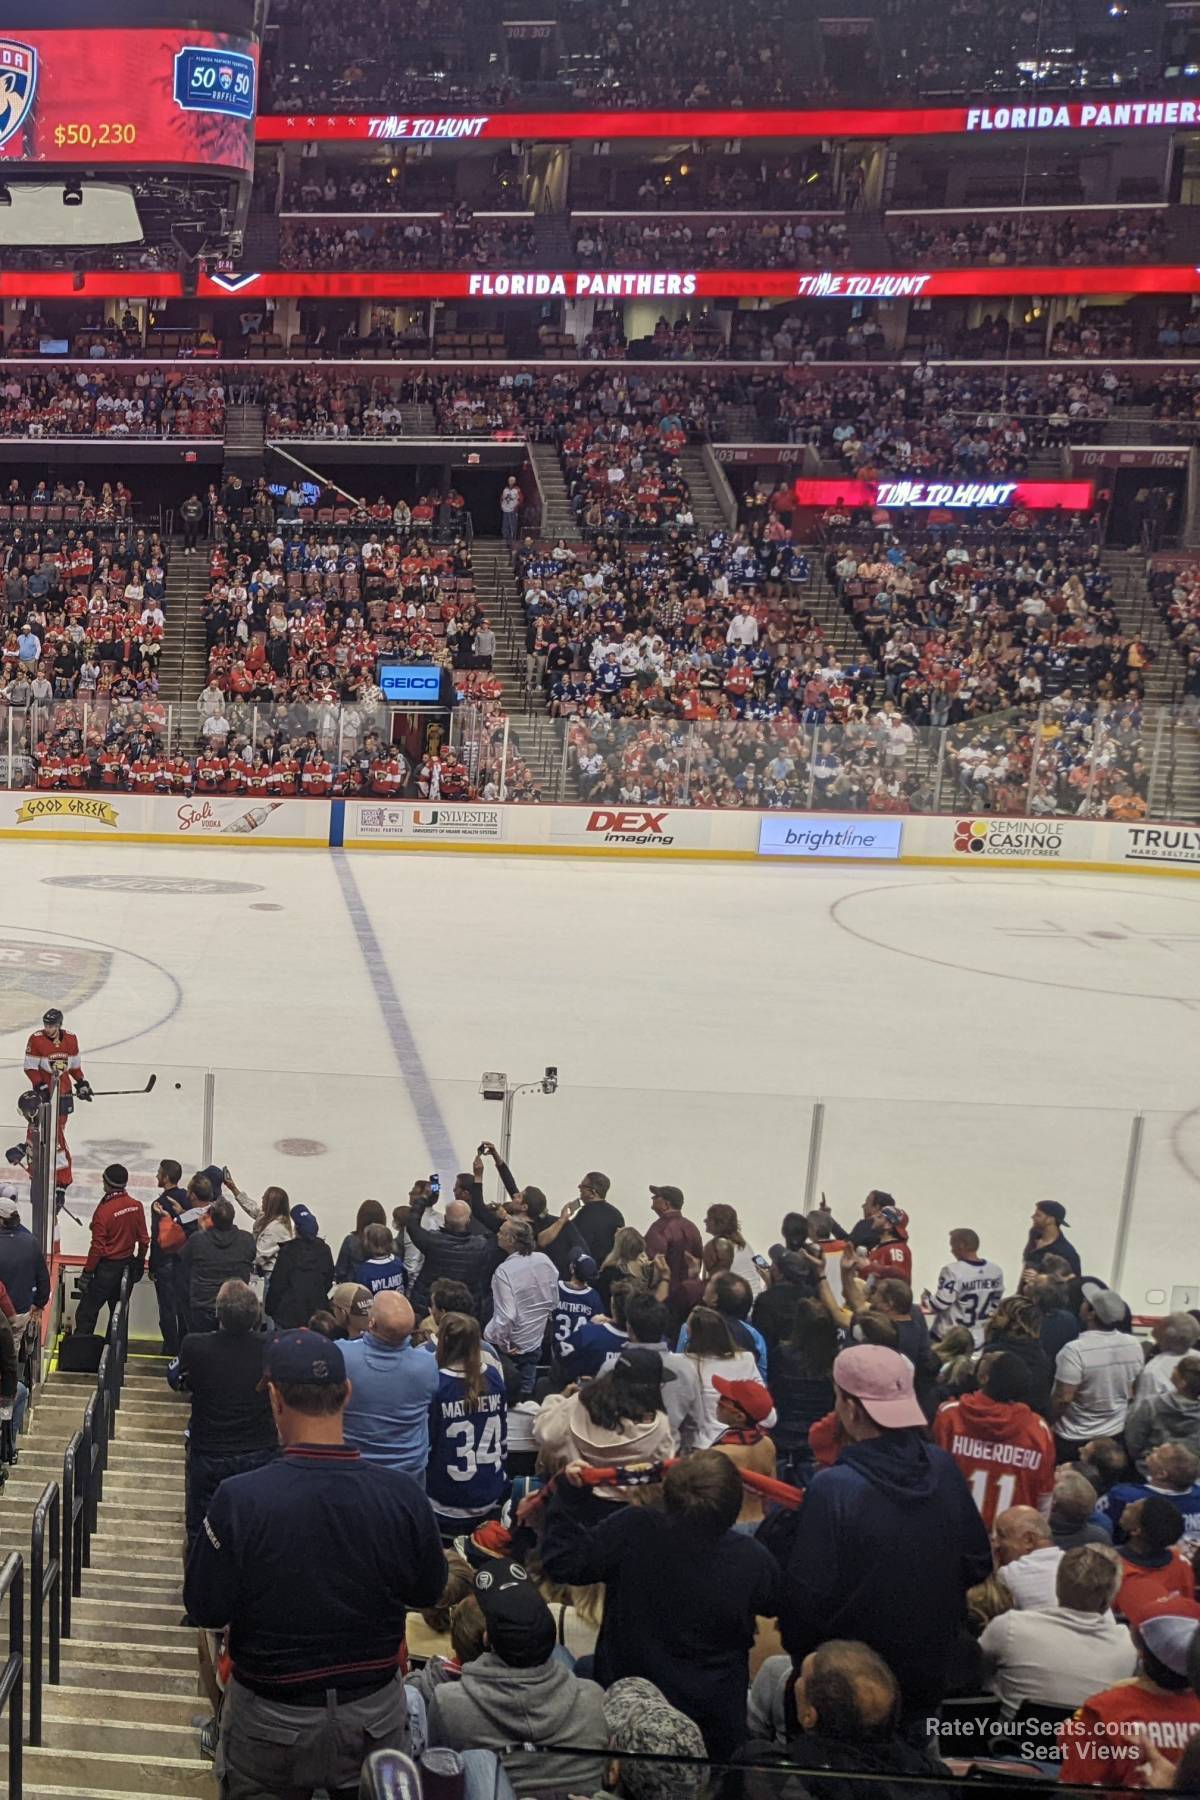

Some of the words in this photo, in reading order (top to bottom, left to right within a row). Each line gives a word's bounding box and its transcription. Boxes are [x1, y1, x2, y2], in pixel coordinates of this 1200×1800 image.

[191, 66, 216, 88] 50
[234, 73, 250, 94] 50
[212, 90, 236, 102] RAFFLE
[368, 116, 407, 137] TIME
[412, 120, 432, 136] TO
[436, 118, 489, 137] HUNT
[966, 106, 1070, 130] FLORIDA
[54, 124, 136, 148] $50,230
[468, 274, 566, 294] FLORIDA
[575, 274, 696, 294] PANTHERS
[798, 272, 841, 296] TIME
[845, 276, 872, 295] TO
[872, 274, 932, 295] HUNT
[778, 449, 798, 462] 104
[1082, 452, 1106, 464] 104
[1152, 452, 1174, 464] 105
[876, 482, 922, 506] TIME
[927, 484, 953, 506] TO
[953, 482, 1018, 507] HUNT
[382, 677, 438, 689] GEICO
[26, 798, 62, 815] GOOD
[68, 798, 107, 818] GREEK
[177, 802, 214, 831] Stoli
[439, 810, 498, 823] SYLVESTER
[201, 820, 222, 828] VODKA
[586, 811, 669, 832] DEX
[990, 820, 1064, 835] SEMINOLE
[604, 832, 674, 845] imaging
[785, 826, 876, 850] brightline
[988, 834, 1062, 849] CASINO
[986, 848, 1032, 856] COCONUT
[1032, 848, 1060, 856] CREEK
[1132, 848, 1158, 856] HARD
[962, 1280, 1000, 1290] MATTHEWS
[441, 1394, 501, 1419] MATEWS
[446, 1414, 502, 1482] 34
[952, 1436, 1042, 1470] HUBERDEAU
[970, 1470, 1016, 1528] 11
